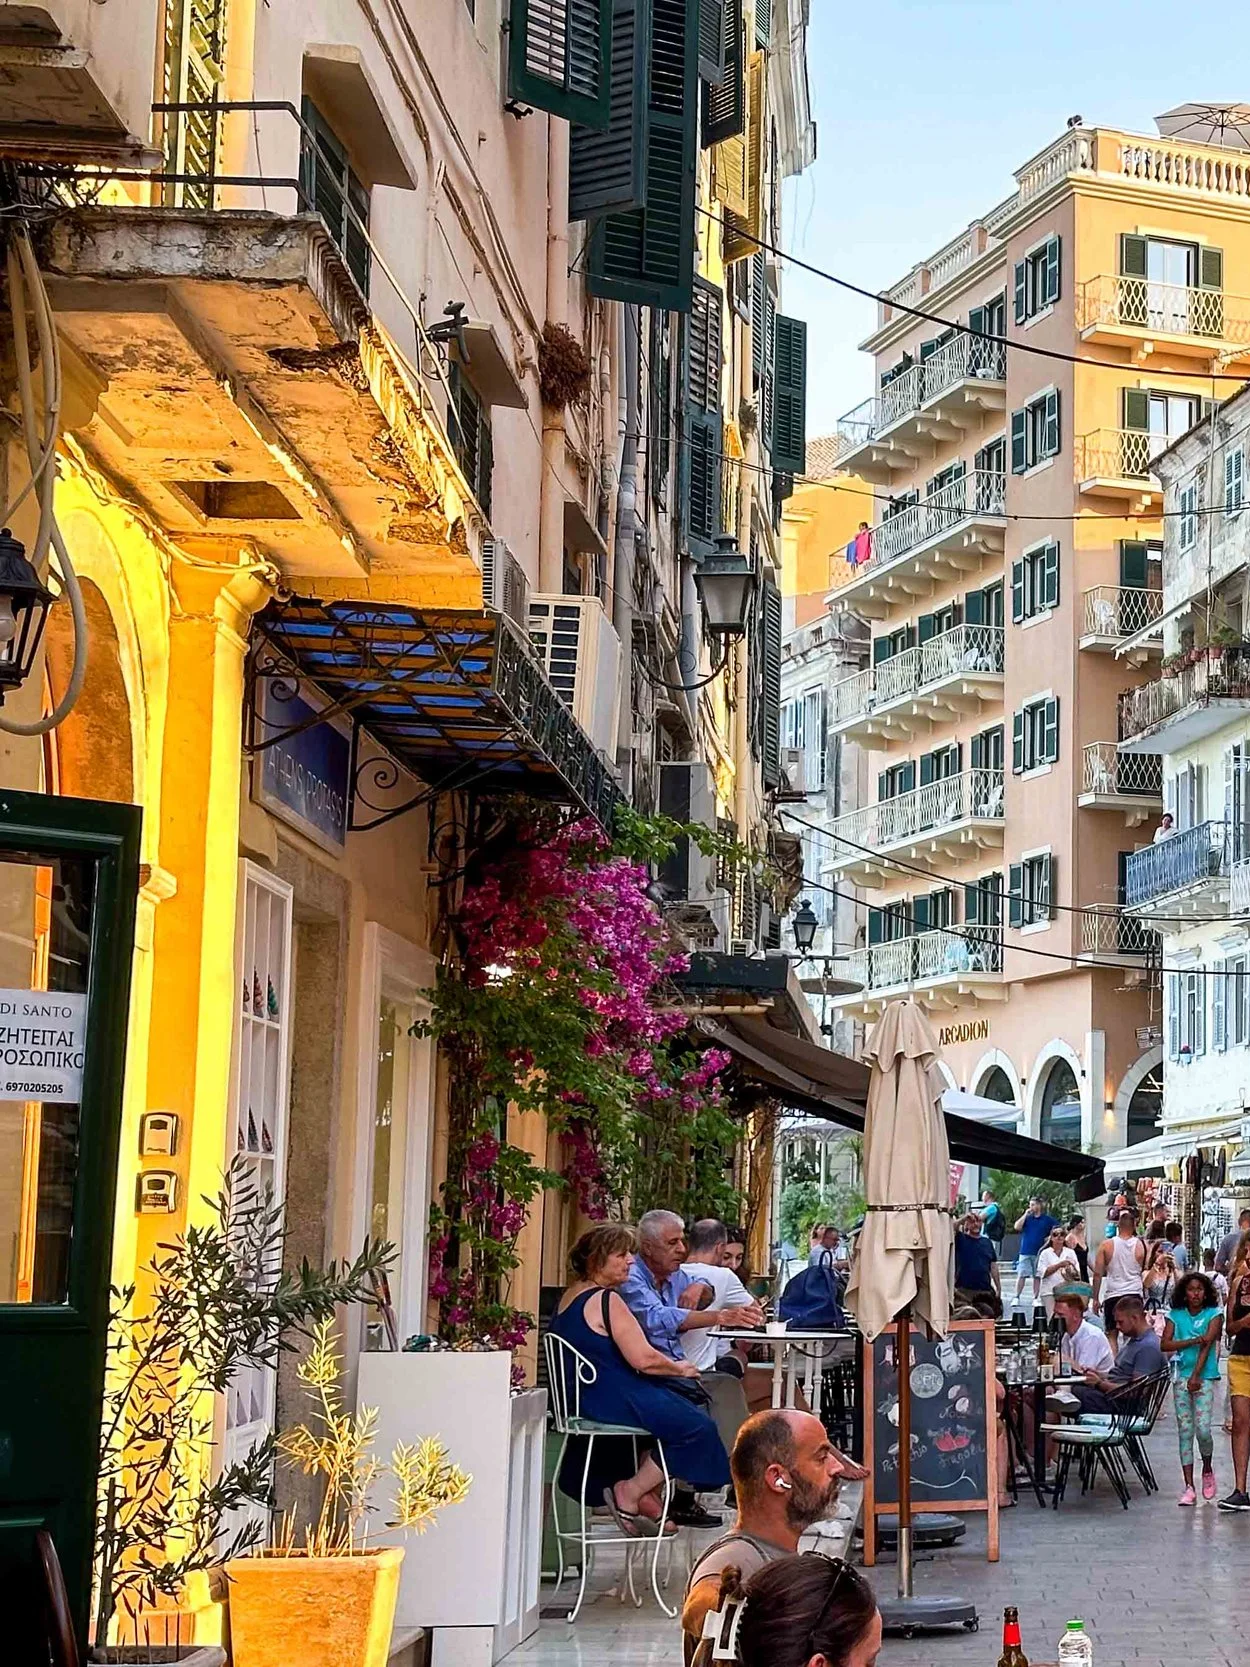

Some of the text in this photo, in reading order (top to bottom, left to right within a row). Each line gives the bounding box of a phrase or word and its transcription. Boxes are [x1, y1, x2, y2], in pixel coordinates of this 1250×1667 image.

[0, 1003, 72, 1019] DI SANTO
[938, 1019, 988, 1047] ARCADION
[5, 1082, 63, 1093] 6970205205
